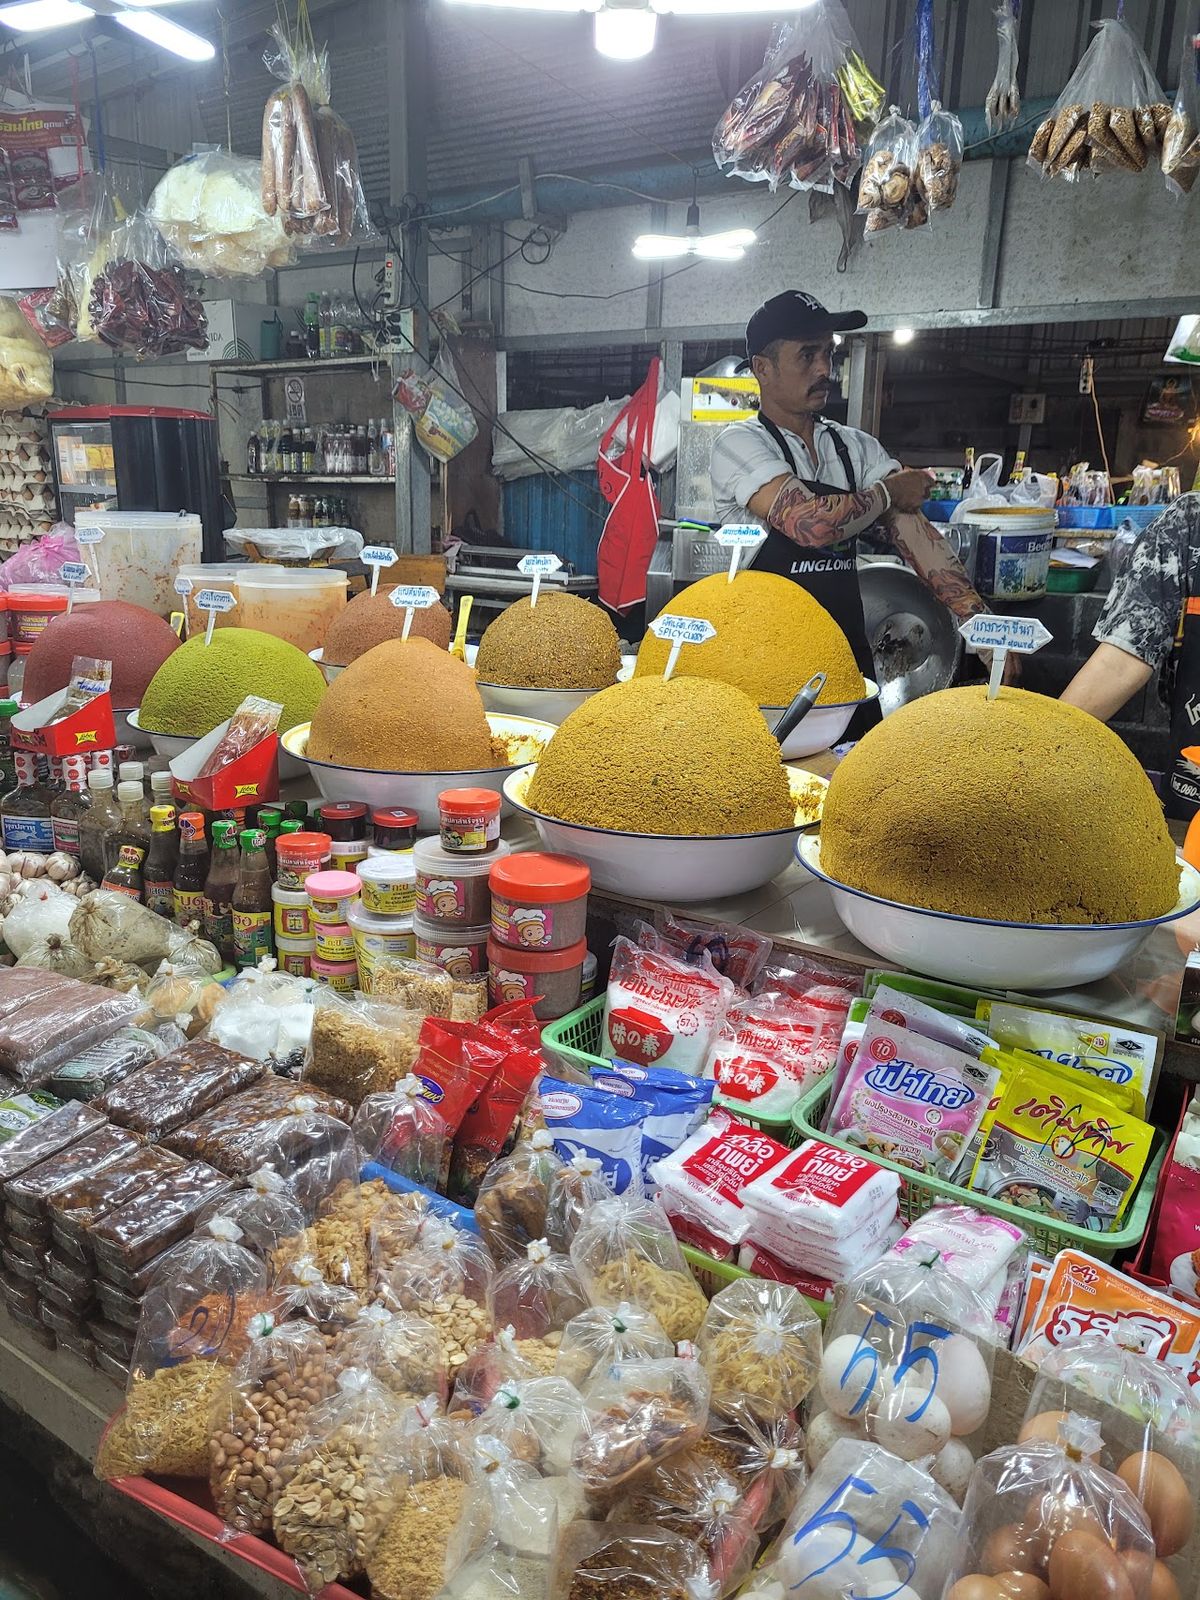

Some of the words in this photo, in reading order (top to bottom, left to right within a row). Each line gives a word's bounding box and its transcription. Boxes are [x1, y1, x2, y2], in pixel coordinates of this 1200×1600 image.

[790, 559, 851, 574] LINGLONG
[658, 626, 682, 637] SPICY
[612, 1020, 661, 1058] 味の素
[873, 1059, 969, 1110] ฟ้าไทย
[864, 1098, 918, 1129] ผงปรุงรสอาหาร
[919, 1123, 938, 1137] รสไก่
[711, 1141, 764, 1176] ทิพย์
[802, 1156, 858, 1182] ทิพย์
[816, 1146, 867, 1169] เกลือ
